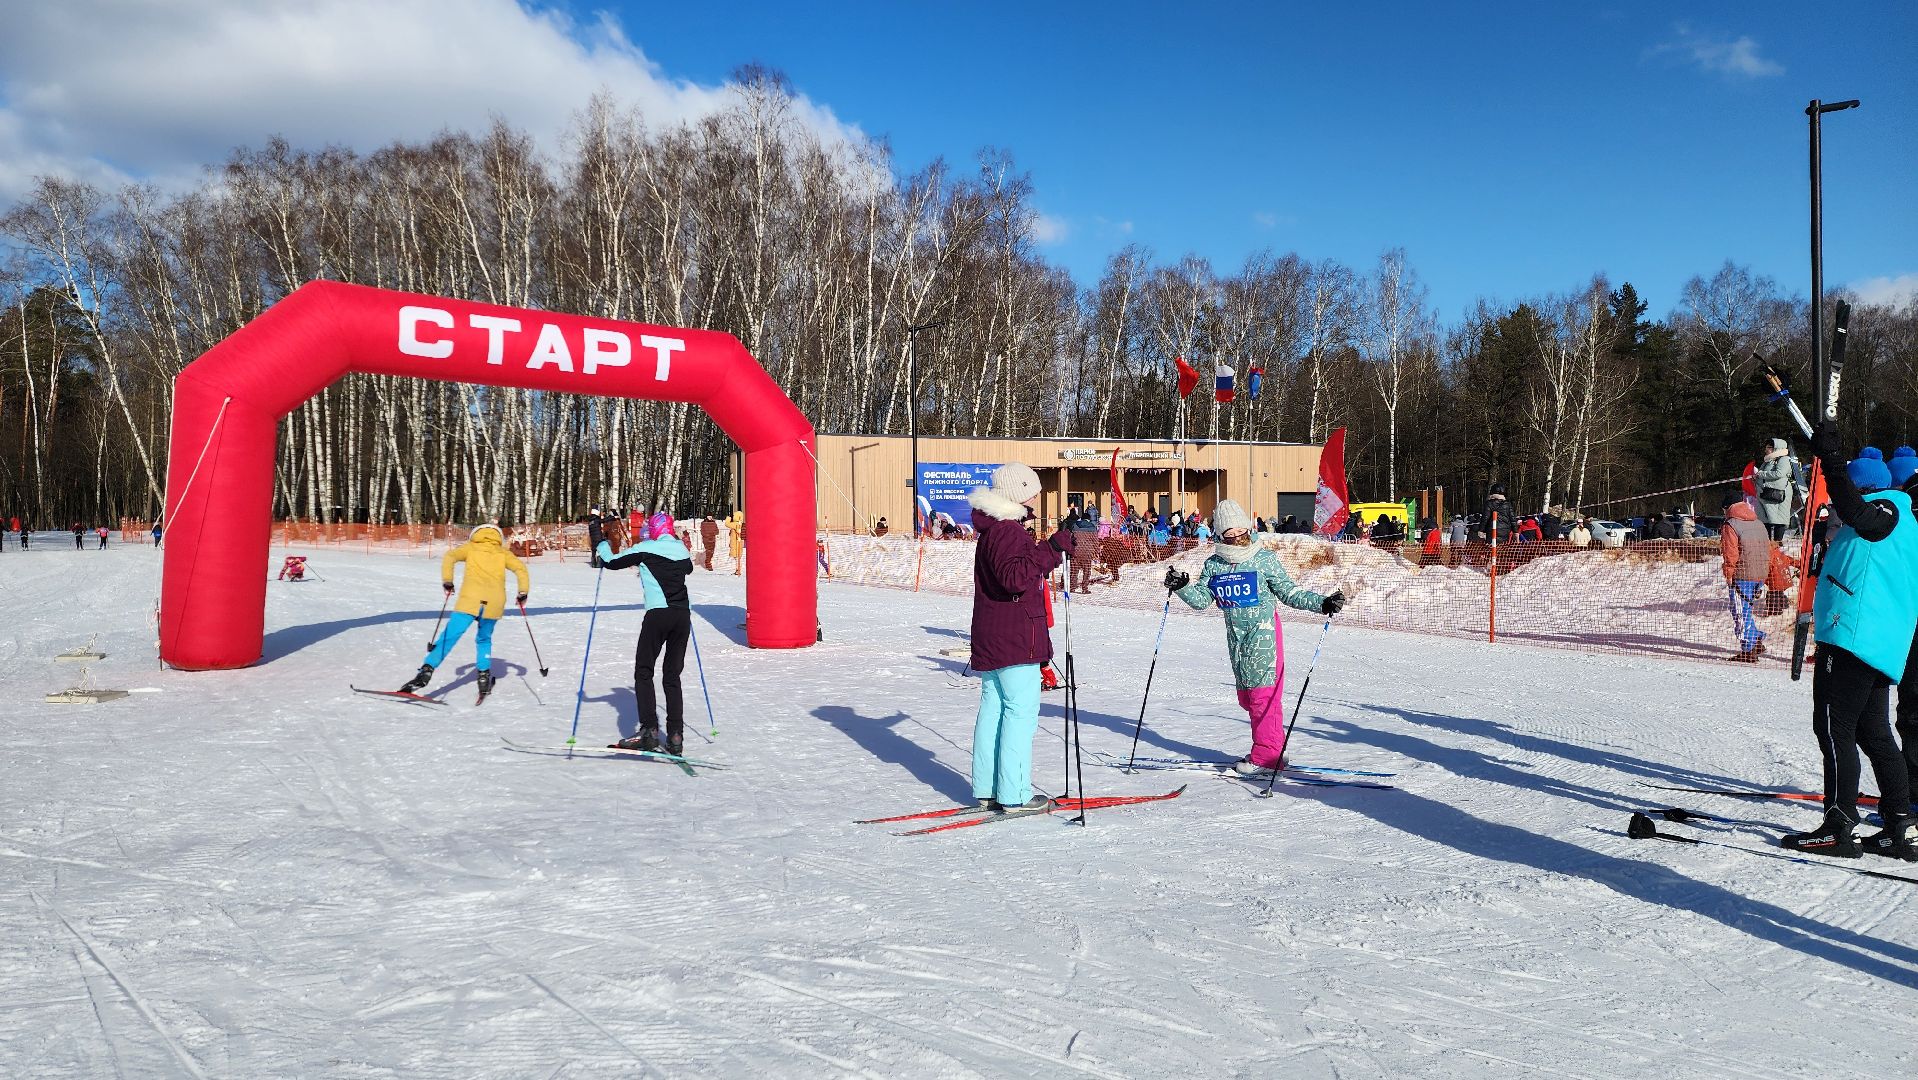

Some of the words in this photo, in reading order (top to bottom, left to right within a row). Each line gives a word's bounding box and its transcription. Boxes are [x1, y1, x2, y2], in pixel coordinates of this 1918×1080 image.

[398, 305, 686, 382] СТАРТ
[923, 471, 972, 479] ФЕСТИВАЛЬ
[1216, 583, 1251, 597] 0003
[1798, 835, 1836, 845] SPINE
